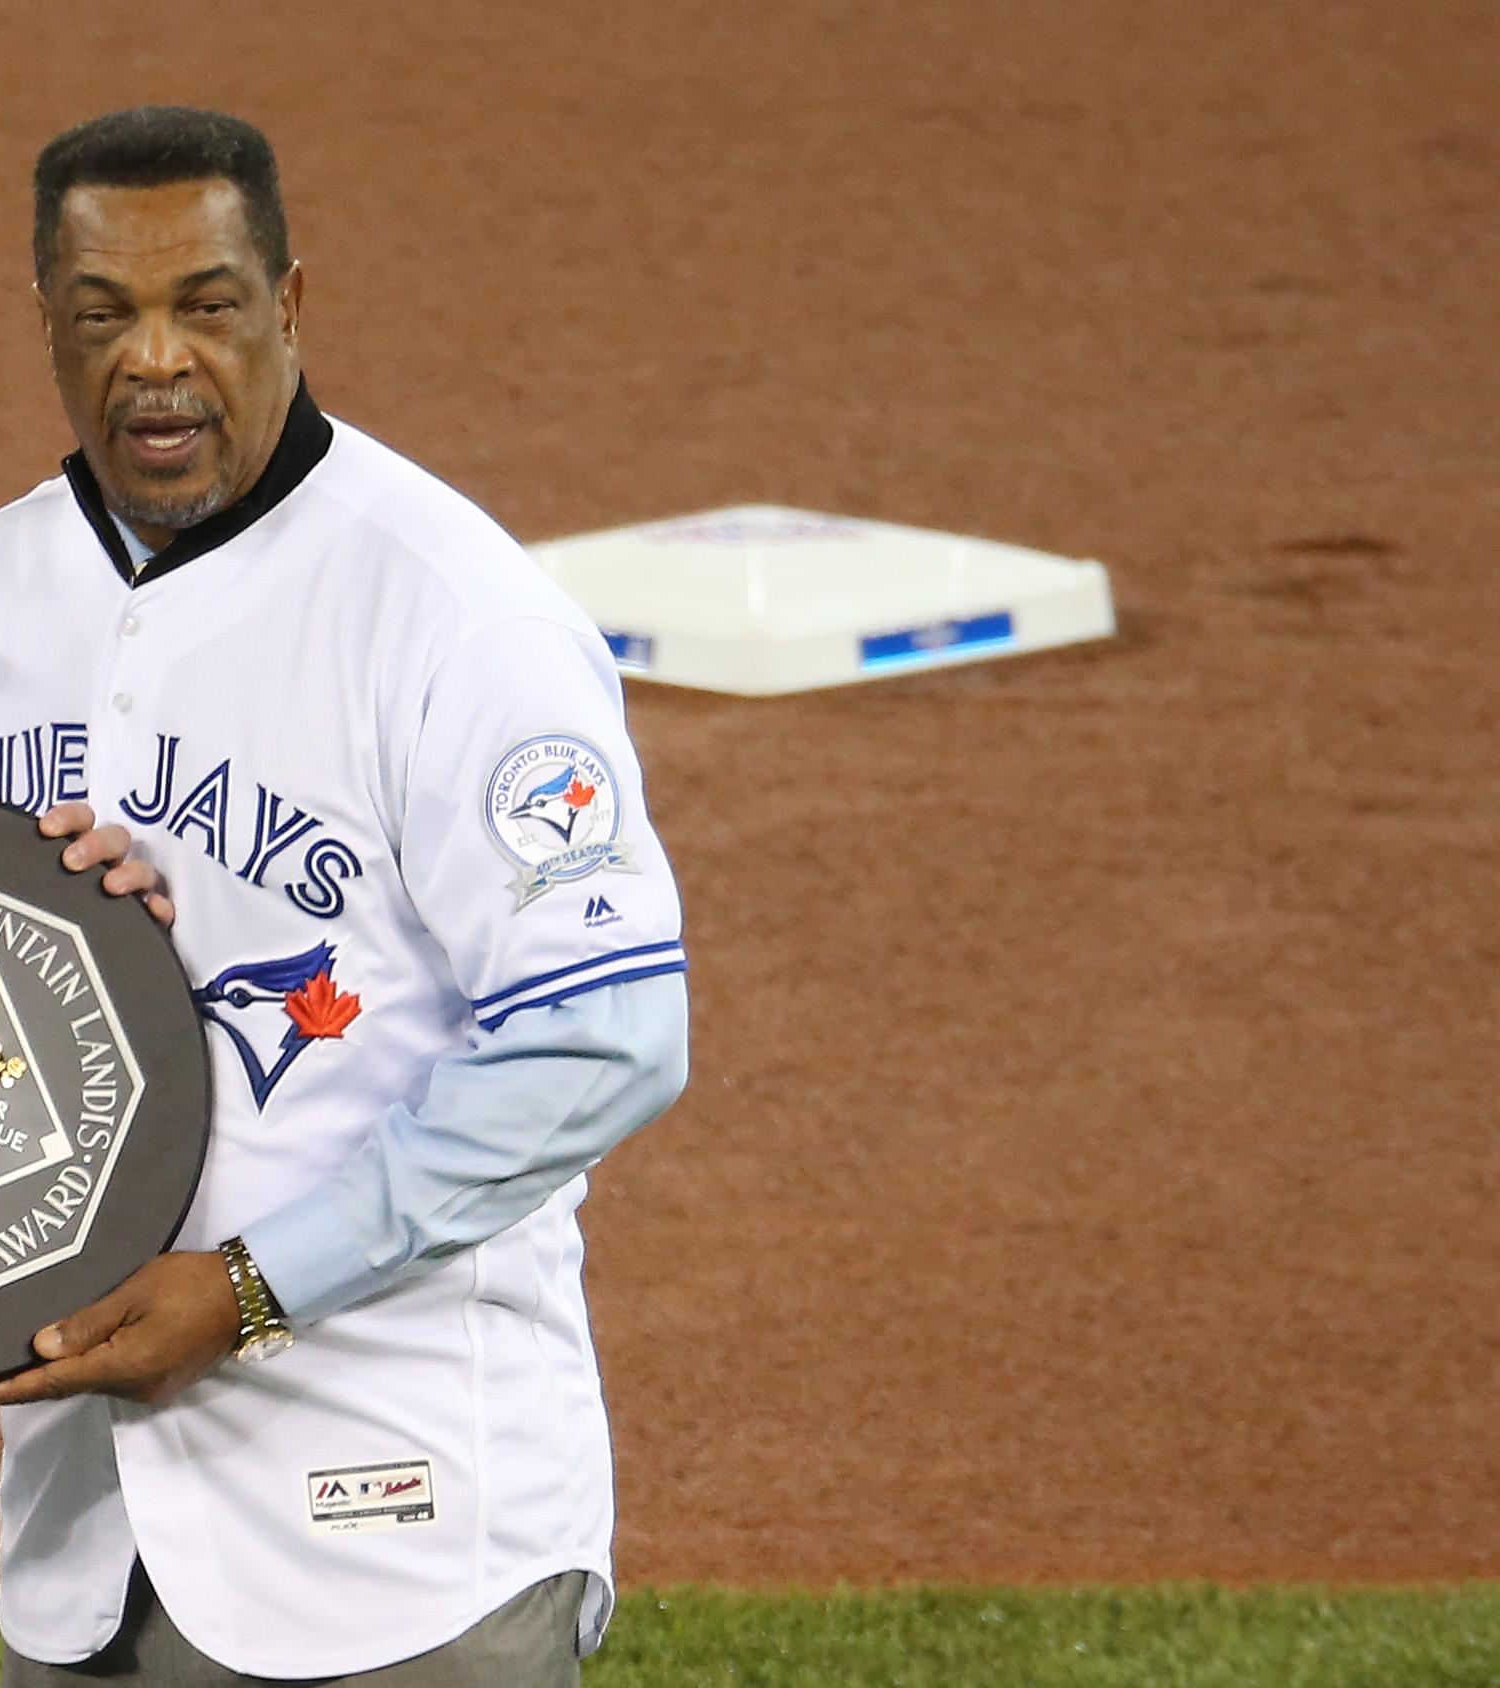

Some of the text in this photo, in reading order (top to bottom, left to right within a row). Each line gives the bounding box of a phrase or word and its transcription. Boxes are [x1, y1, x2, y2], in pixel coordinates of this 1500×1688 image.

[119, 734, 363, 919] JAYS
[495, 745, 606, 814] TORONTO BLUE JAYS
[564, 843, 613, 864] SEASON
[70, 1008, 117, 1151] LANDIS
